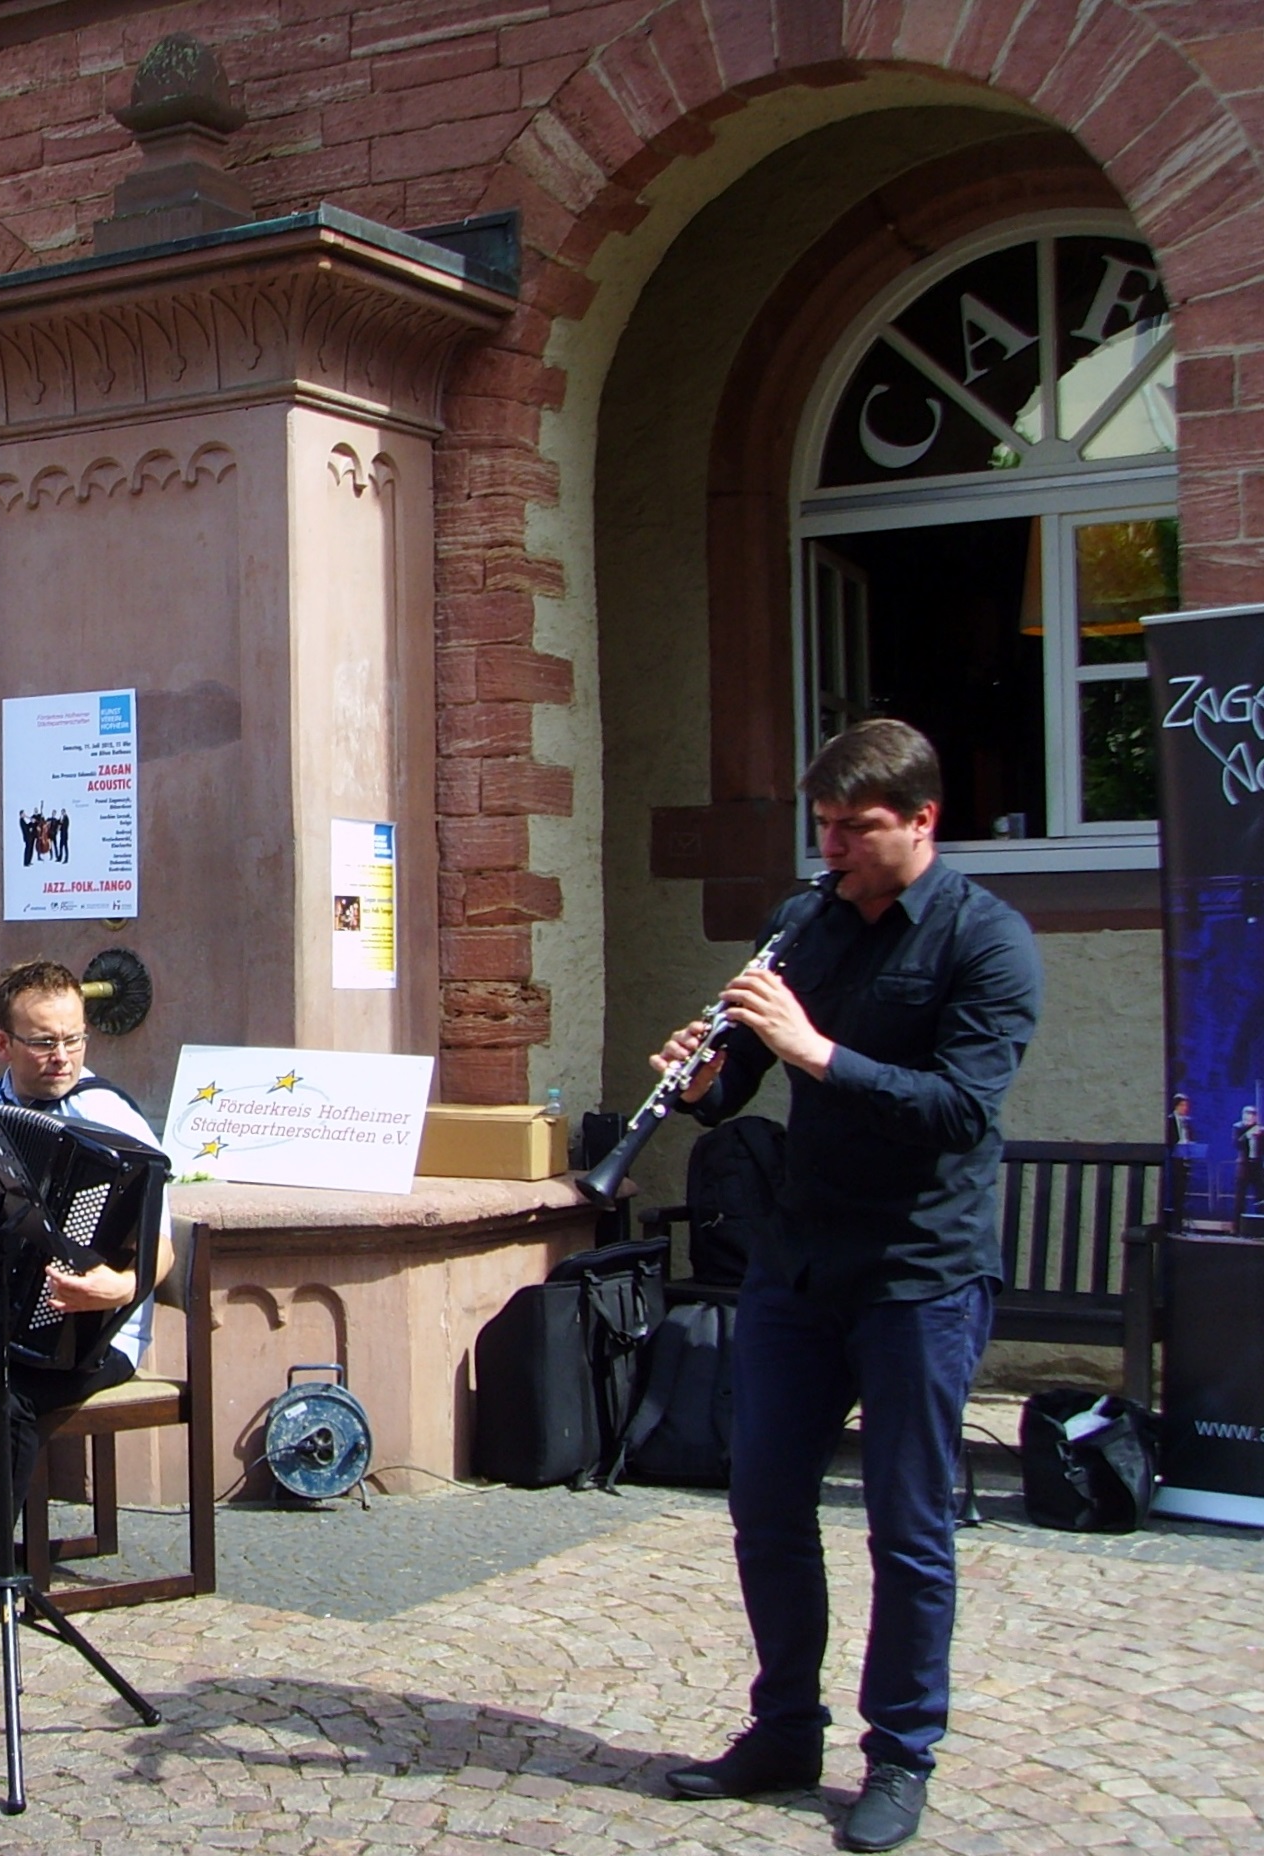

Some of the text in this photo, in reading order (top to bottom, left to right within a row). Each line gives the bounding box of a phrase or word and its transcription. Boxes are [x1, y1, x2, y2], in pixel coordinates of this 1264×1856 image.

[859, 254, 1176, 469] CAF
[98, 763, 132, 777] ZAGAN
[87, 778, 132, 792] ACOUSTIC
[217, 1098, 412, 1126] Förderkreis Hofheimer
[190, 1117, 409, 1146] Städtepartnerschaften e.V.
